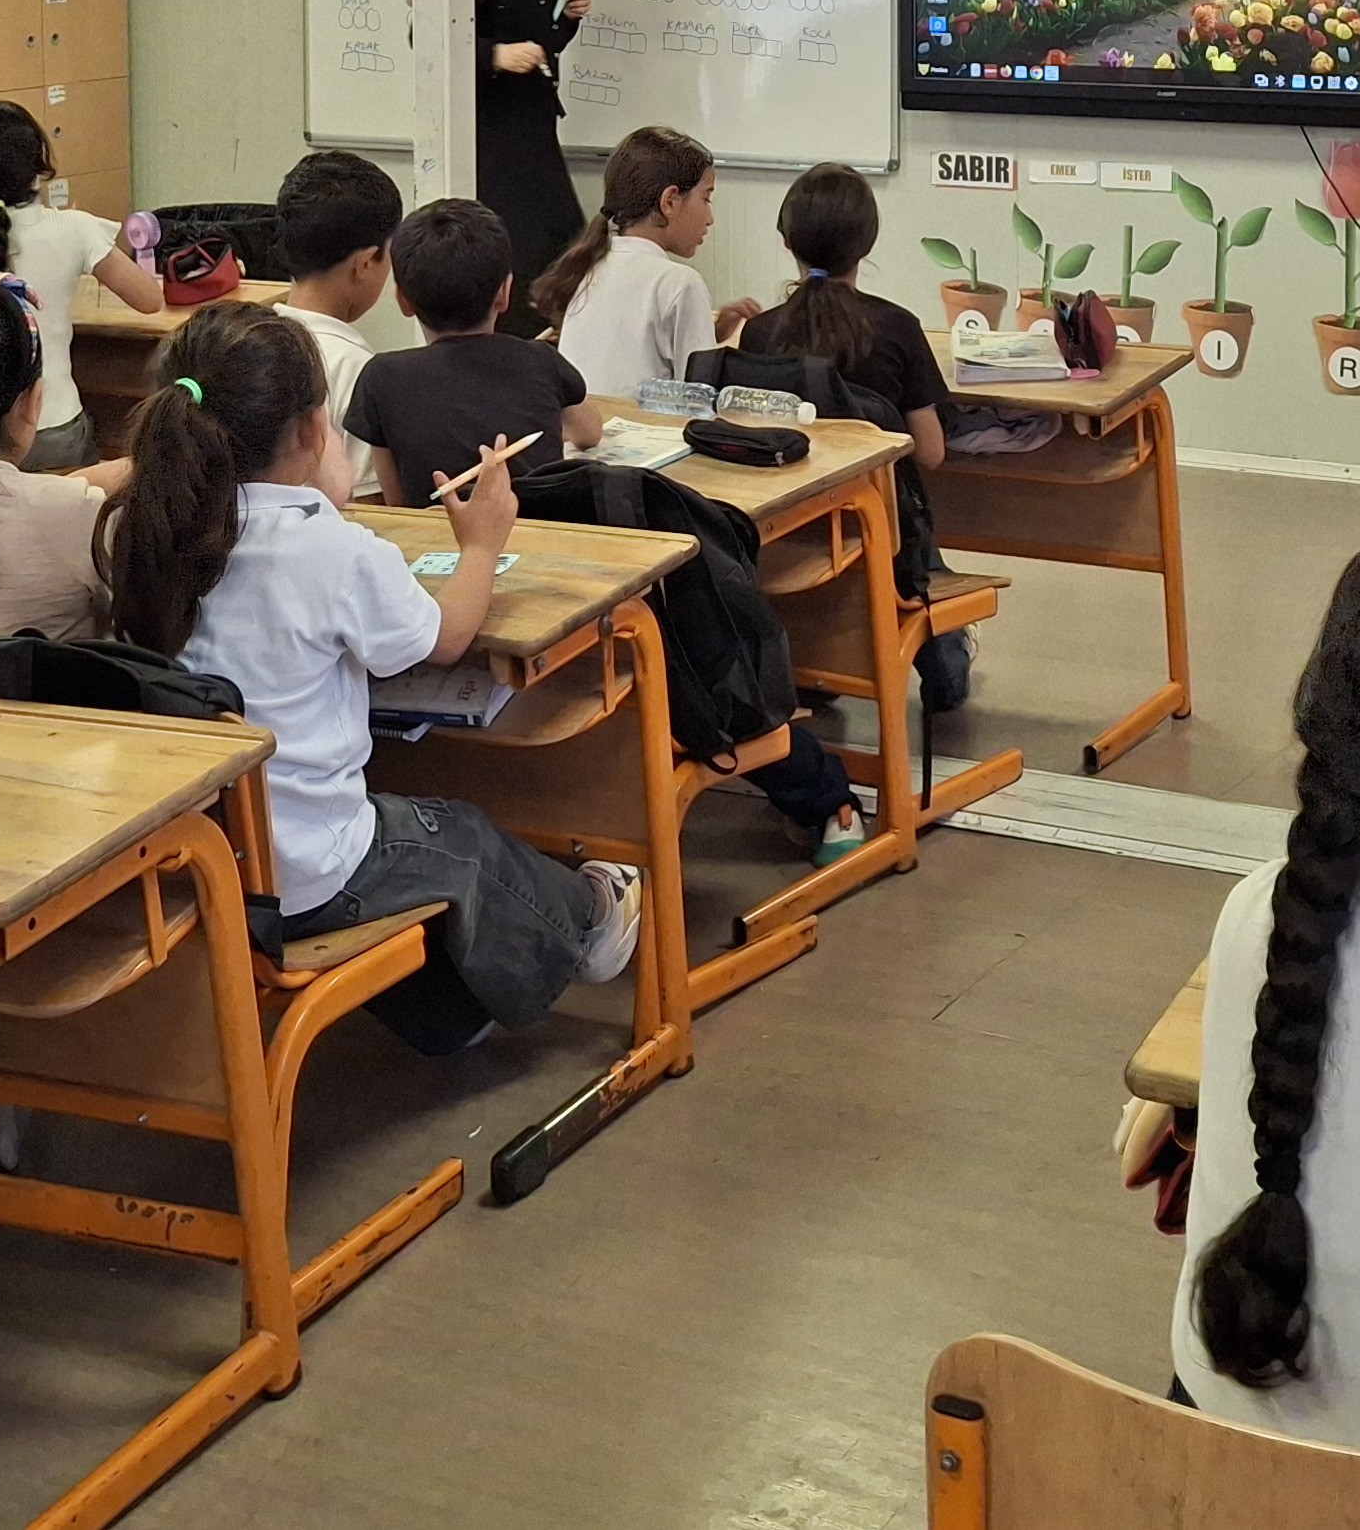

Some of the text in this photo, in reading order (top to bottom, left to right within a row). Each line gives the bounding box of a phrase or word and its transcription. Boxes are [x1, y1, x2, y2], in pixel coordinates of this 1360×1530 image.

[938, 153, 1011, 184] SABIR
[1050, 164, 1078, 177] EMEK
[1122, 166, 1152, 182] İSTER
[1339, 358, 1358, 379] R
